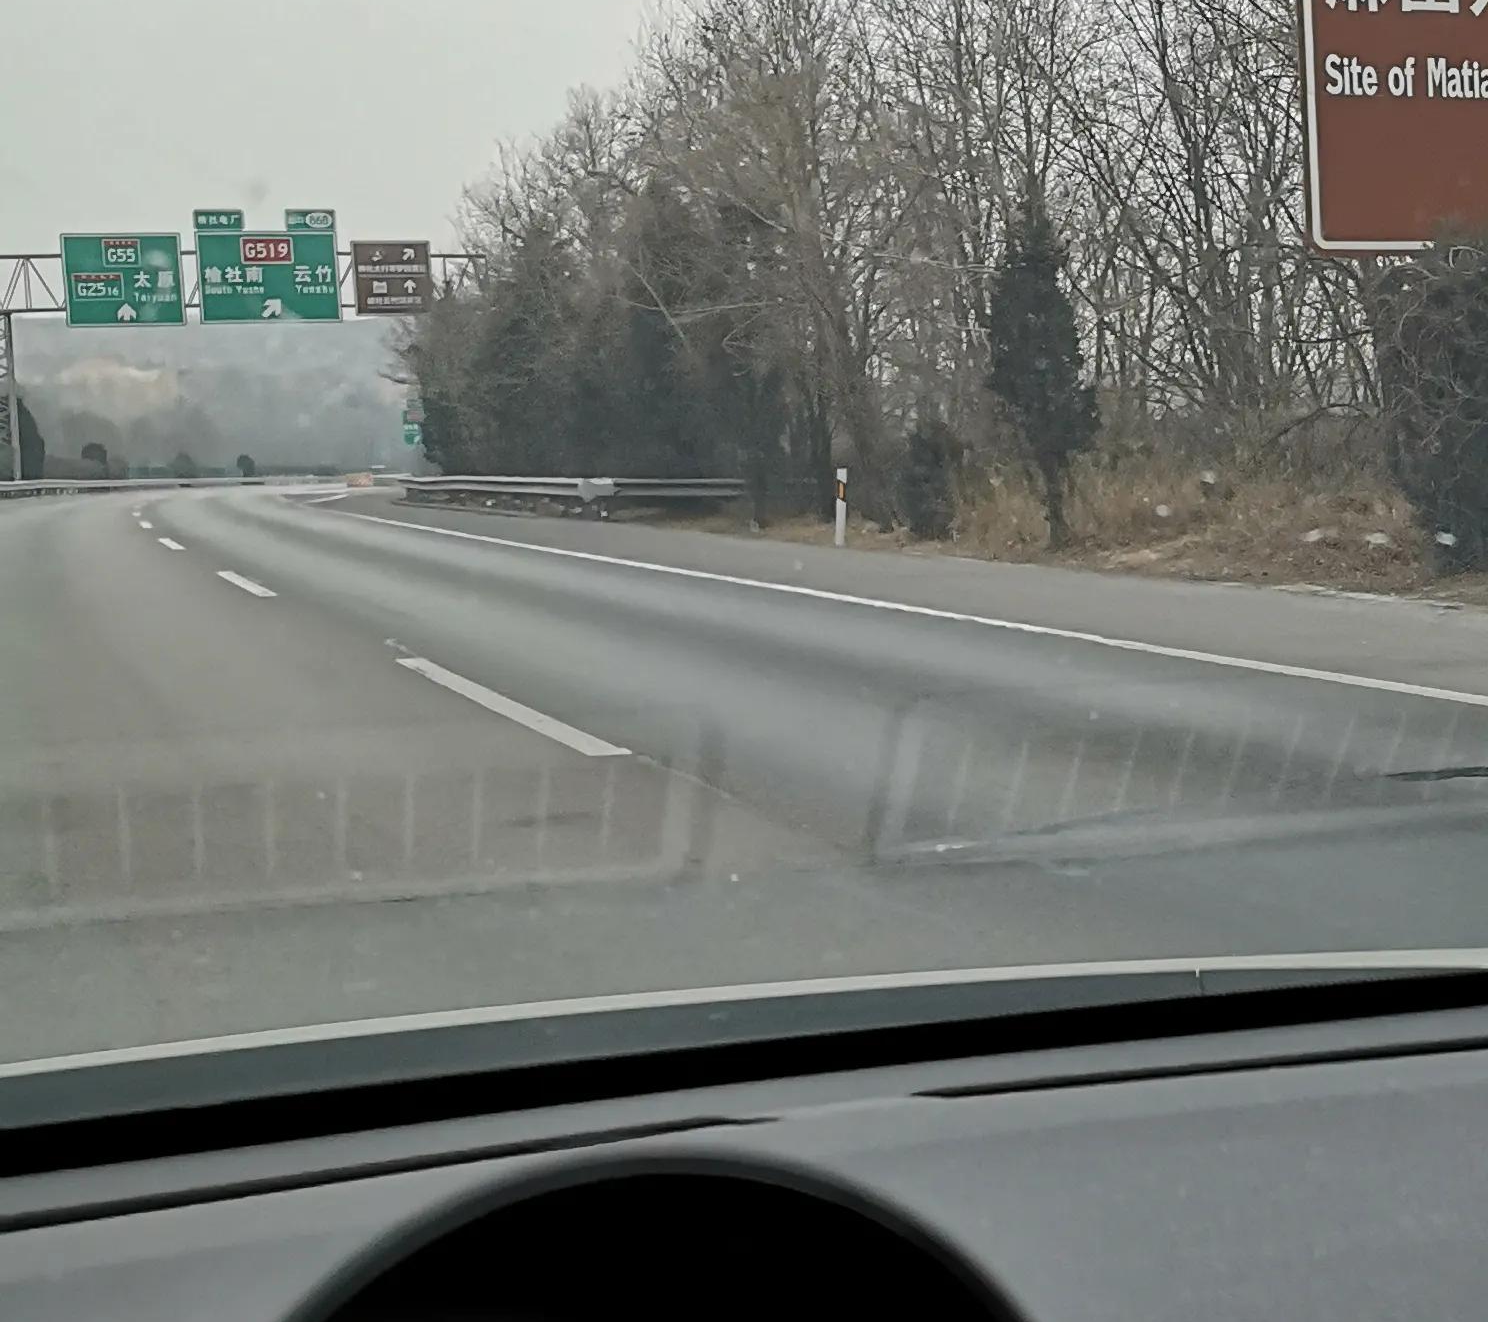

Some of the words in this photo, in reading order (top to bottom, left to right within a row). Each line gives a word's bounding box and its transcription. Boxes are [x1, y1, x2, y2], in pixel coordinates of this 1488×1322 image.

[1325, 54, 1378, 97] Site
[1388, 56, 1416, 99] of
[107, 248, 136, 262] G55
[245, 243, 288, 258] G519
[293, 265, 332, 283] 云竹
[77, 282, 119, 296] G2516
